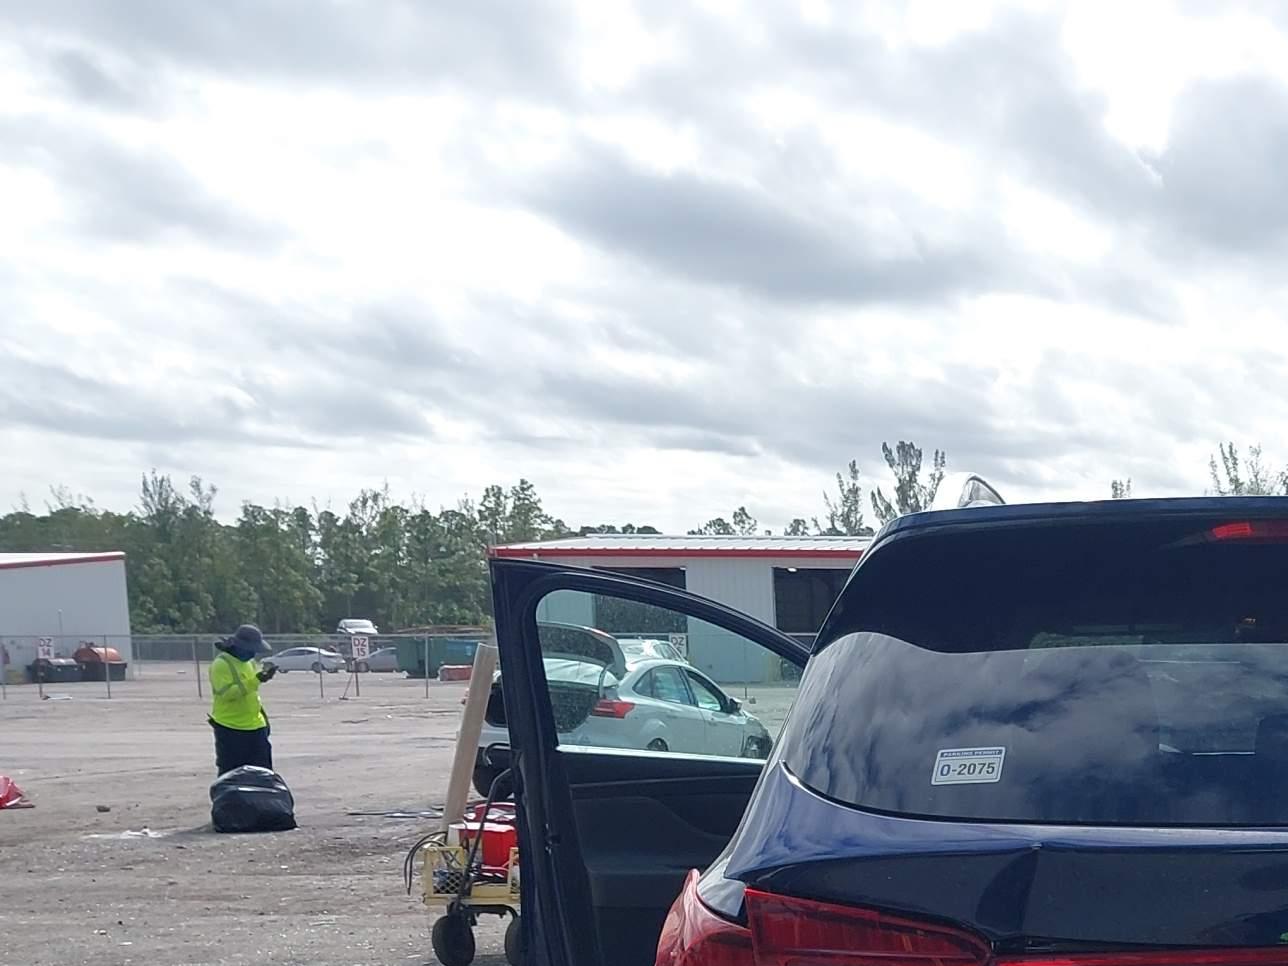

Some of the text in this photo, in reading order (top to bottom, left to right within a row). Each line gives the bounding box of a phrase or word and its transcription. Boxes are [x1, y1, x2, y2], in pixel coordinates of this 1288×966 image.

[353, 637, 367, 647] DZ
[671, 636, 685, 647] DZ
[356, 647, 366, 657] 15
